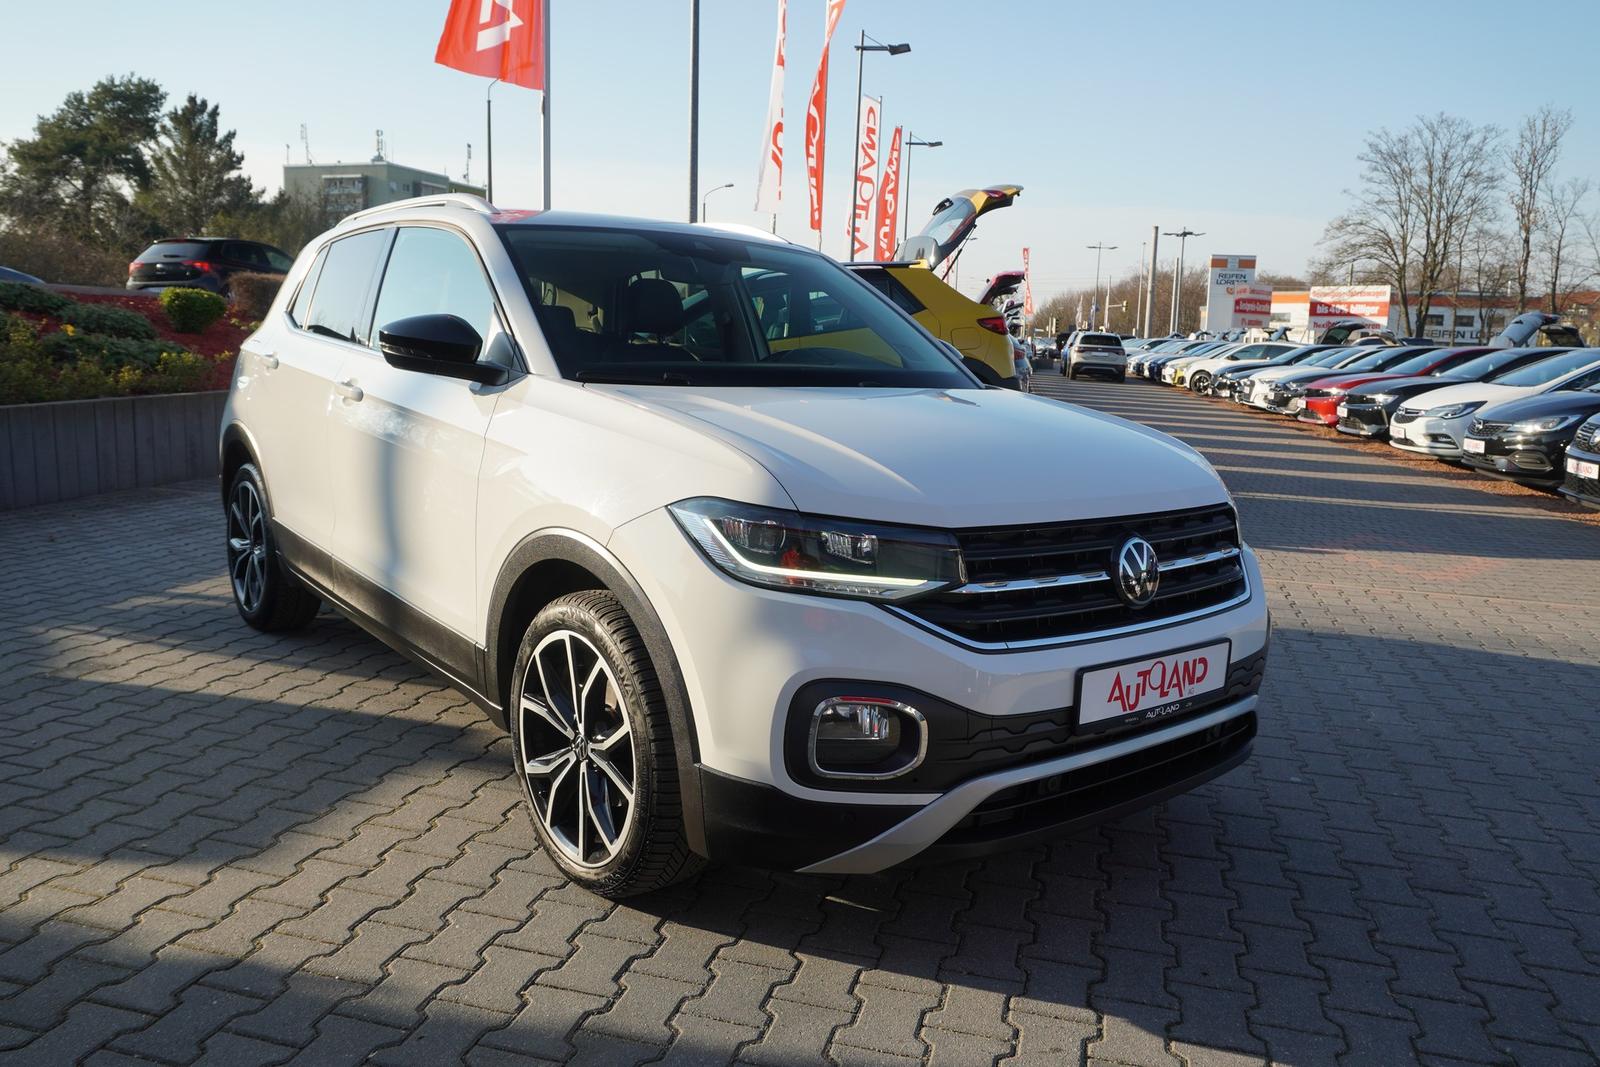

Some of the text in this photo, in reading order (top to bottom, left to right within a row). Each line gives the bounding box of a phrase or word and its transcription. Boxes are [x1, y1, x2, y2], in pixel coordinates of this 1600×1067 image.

[1316, 304, 1329, 314] bis
[1107, 657, 1208, 712] AUTOLAND
[1145, 703, 1180, 718] AUTOLAND
